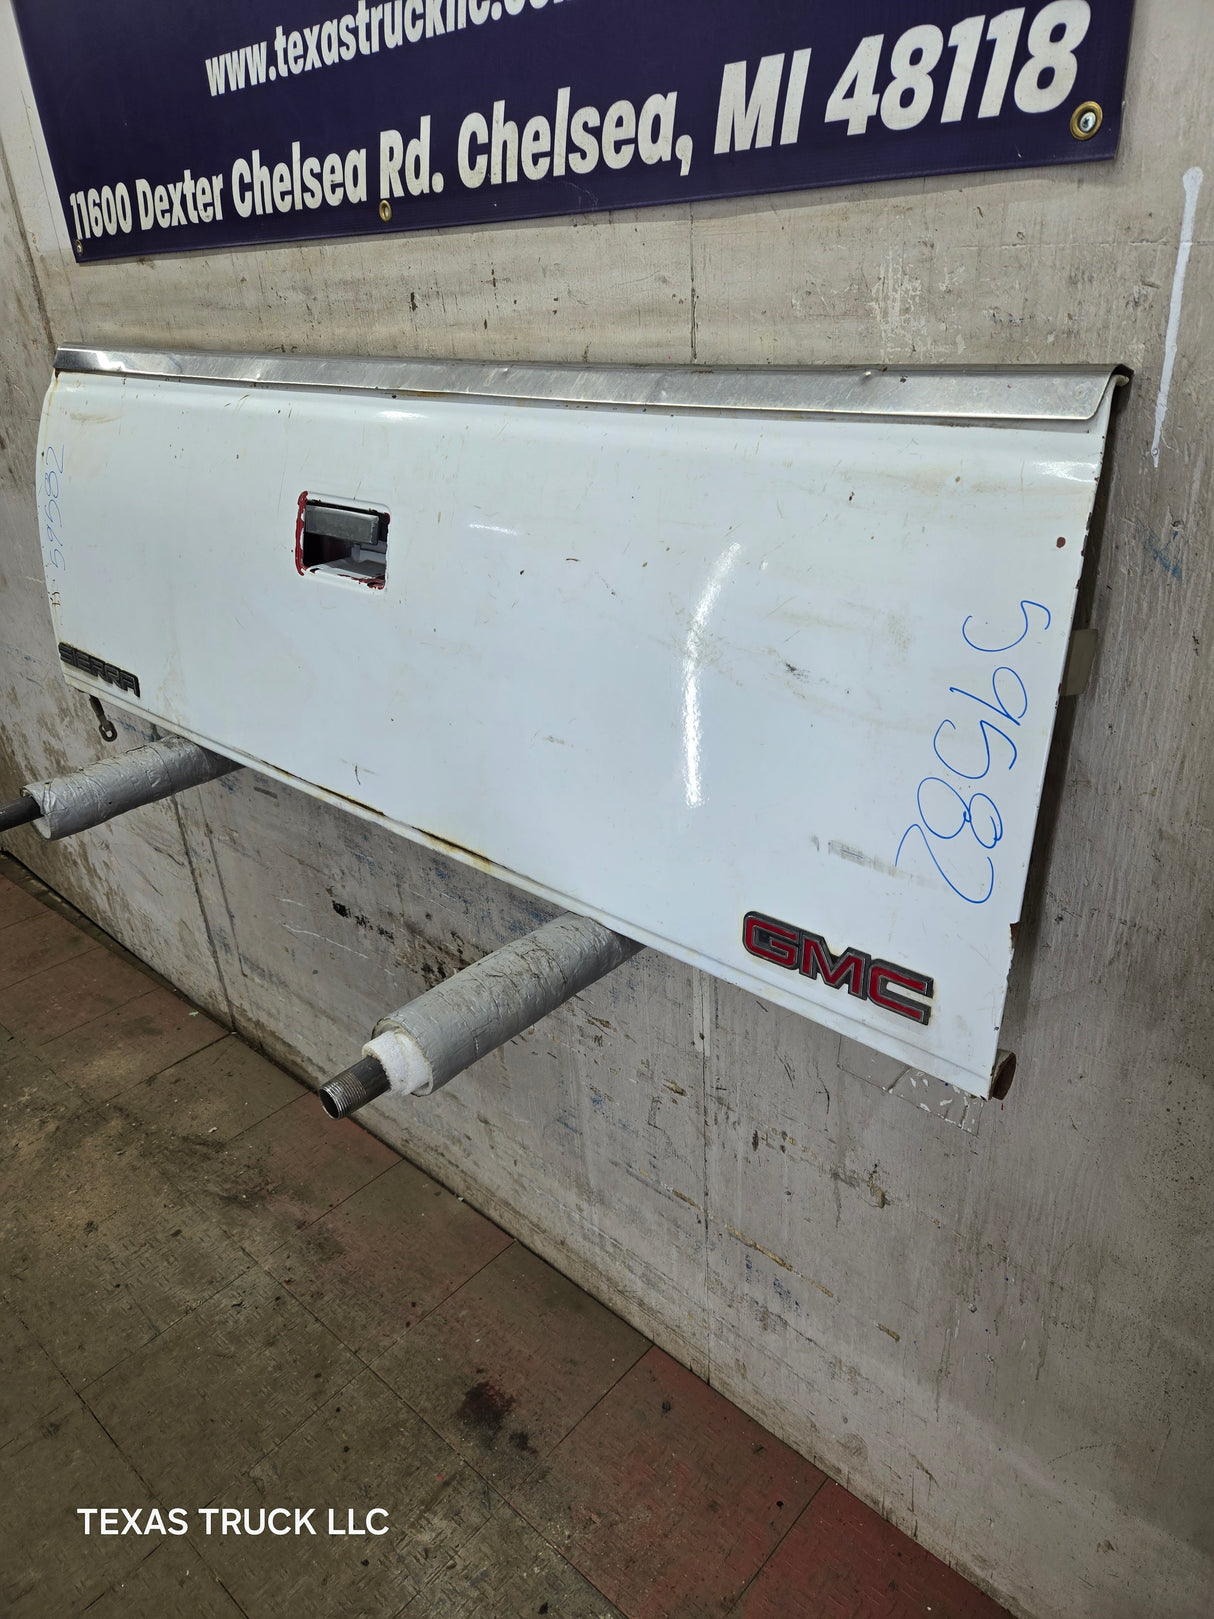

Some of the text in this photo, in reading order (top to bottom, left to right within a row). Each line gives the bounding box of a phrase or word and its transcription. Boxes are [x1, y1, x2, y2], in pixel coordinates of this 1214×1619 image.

[69, 0, 1092, 240] 11600 Dexter Chelsea Rd. Chelsea, MI 48118
[58, 642, 141, 698] SIERRA
[894, 600, 1051, 904] 59582
[742, 910, 934, 1026] GMC
